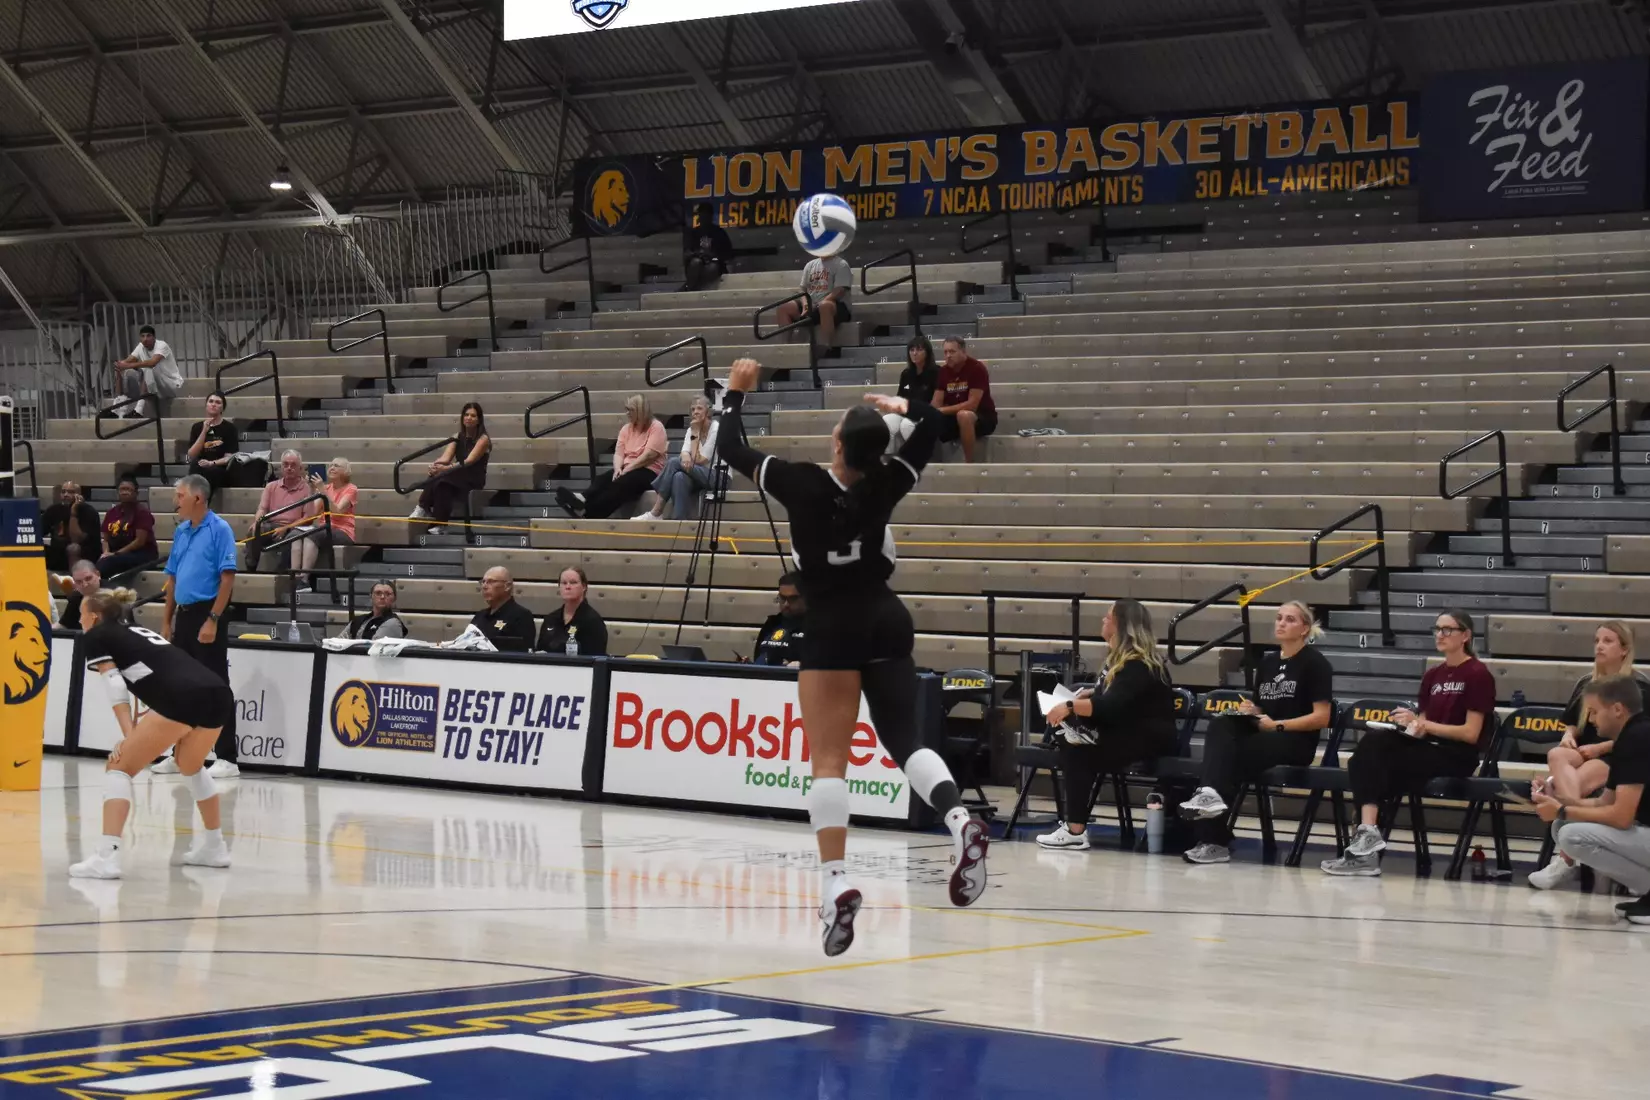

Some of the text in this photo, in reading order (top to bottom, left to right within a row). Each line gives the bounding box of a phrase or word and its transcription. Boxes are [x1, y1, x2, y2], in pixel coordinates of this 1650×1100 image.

[1467, 79, 1585, 147] Fix &
[683, 101, 1420, 199] LION MEN'S BASKETBALL
[1485, 132, 1593, 193] Feed
[1195, 156, 1411, 199] 30 ALL-AMERICANS
[719, 201, 749, 229] LSC
[924, 188, 935, 217] 7
[940, 185, 992, 215] NCAA
[379, 687, 434, 712] Hilton
[942, 677, 987, 688] LIONS
[390, 722, 419, 731] LAKEFRONT
[443, 688, 585, 730] BEST PLACE
[376, 737, 434, 748] LION ATHLETICS
[443, 725, 545, 765] TO STAY!
